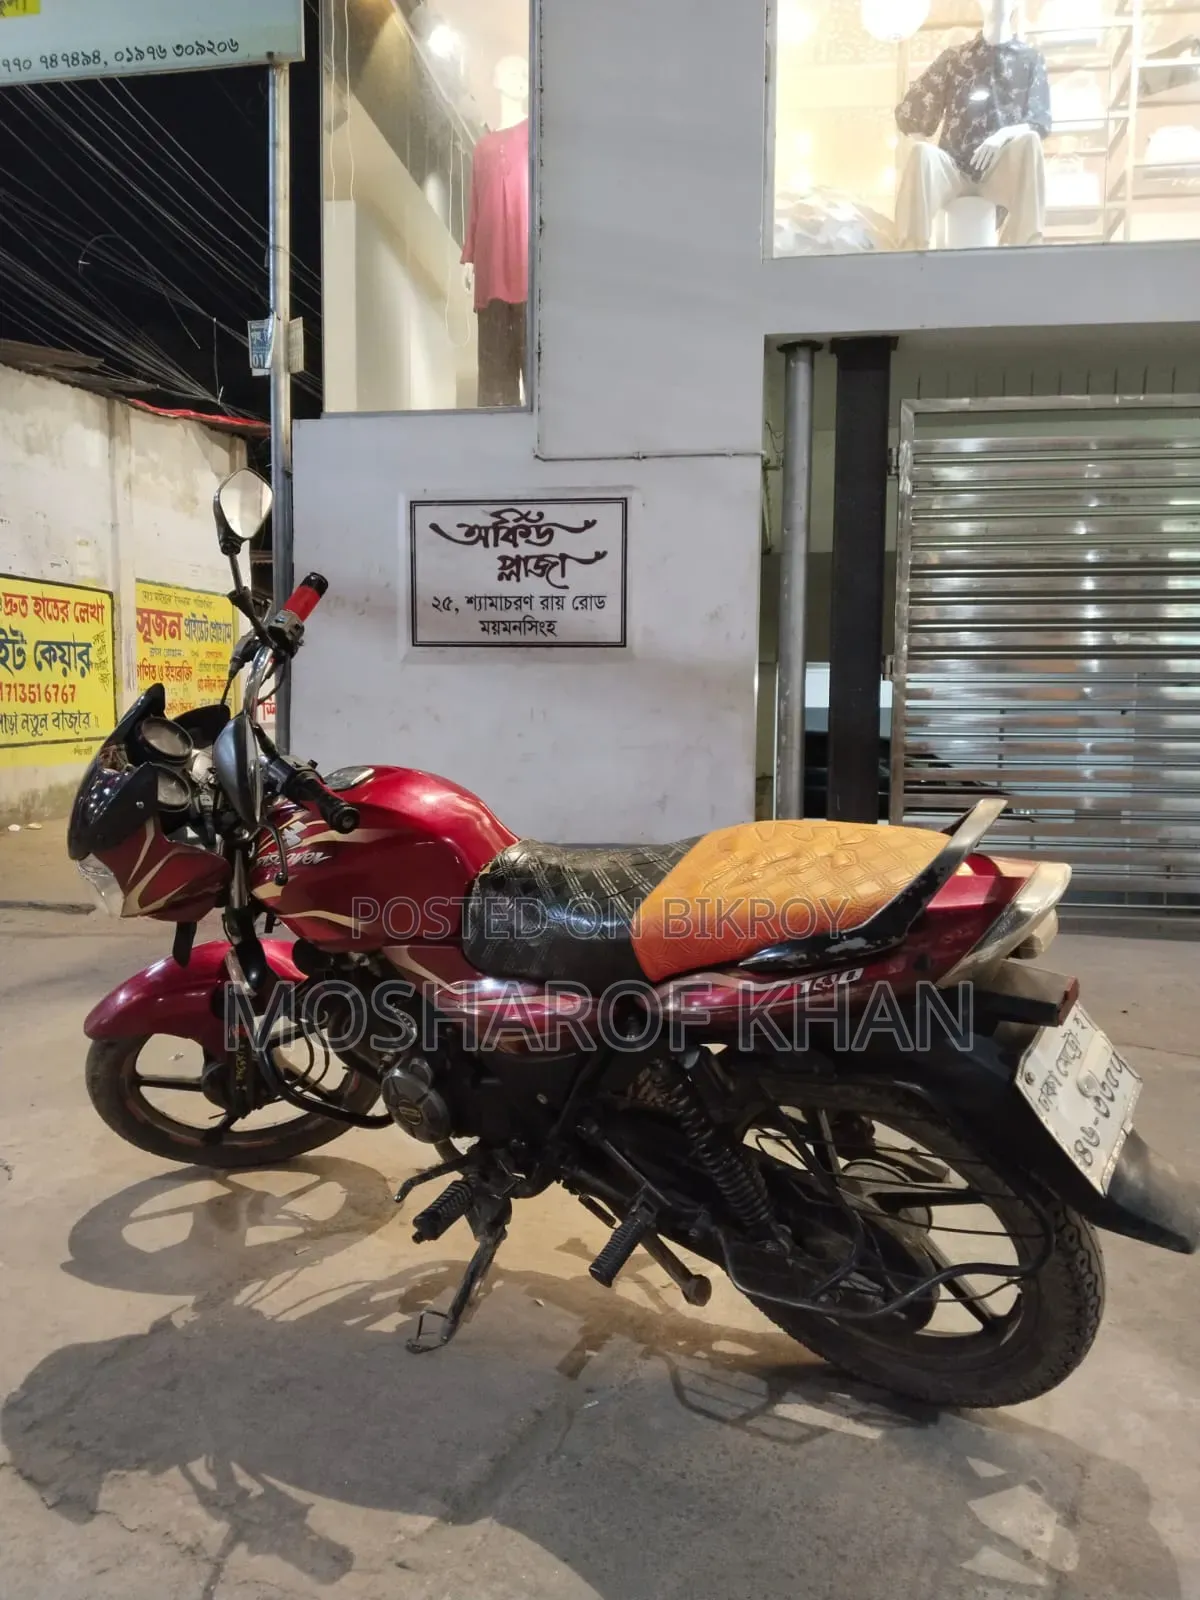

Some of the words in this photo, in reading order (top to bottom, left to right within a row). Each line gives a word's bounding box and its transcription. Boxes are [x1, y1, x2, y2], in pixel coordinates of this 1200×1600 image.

[114, 44, 167, 62] ০১৯৭৬
[172, 38, 240, 57] ৩০৯২০৬
[497, 550, 608, 589] প্লাজা
[2, 592, 28, 618] দ্রুত
[31, 591, 71, 624] হাতের
[73, 597, 105, 626] লেখা
[431, 595, 460, 615] ২৫,
[464, 594, 534, 612] শ্যামাচরণ
[539, 595, 566, 612] রায়
[571, 595, 608, 612] রোড
[478, 614, 558, 637] ময়মনসিংহ
[34, 631, 93, 678] কেয়ার
[21, 712, 49, 738] নতুন
[51, 709, 92, 735] বাজার
[1037, 1071, 1063, 1113] ঢাকা
